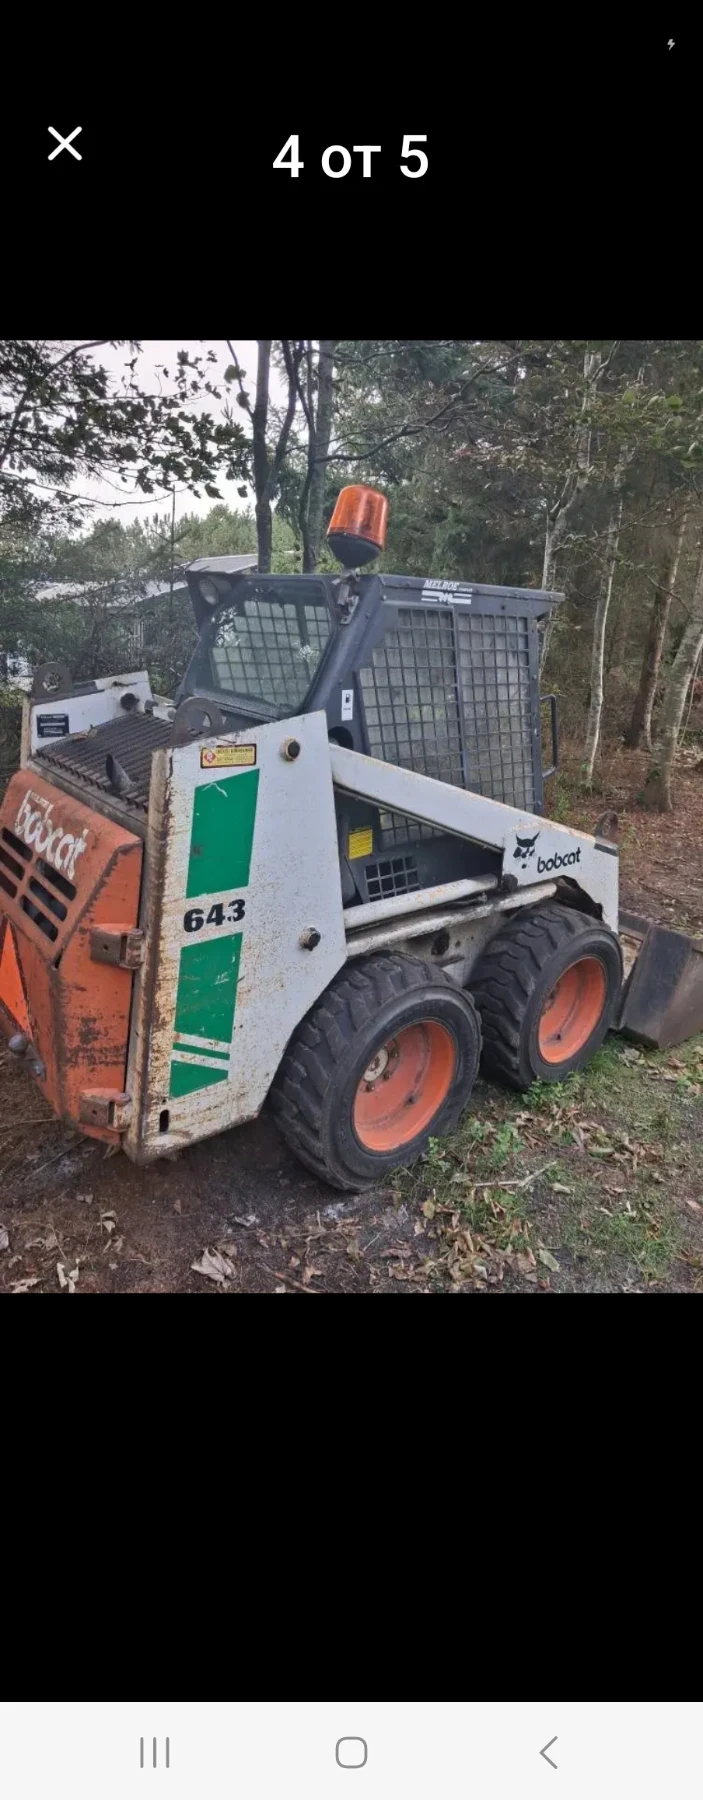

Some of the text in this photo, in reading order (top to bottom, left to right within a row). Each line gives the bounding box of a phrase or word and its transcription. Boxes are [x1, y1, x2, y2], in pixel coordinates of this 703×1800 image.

[423, 579, 460, 591] MELROE
[15, 789, 89, 880] bobcat
[537, 846, 581, 874] bobcat
[183, 899, 246, 933] 643
